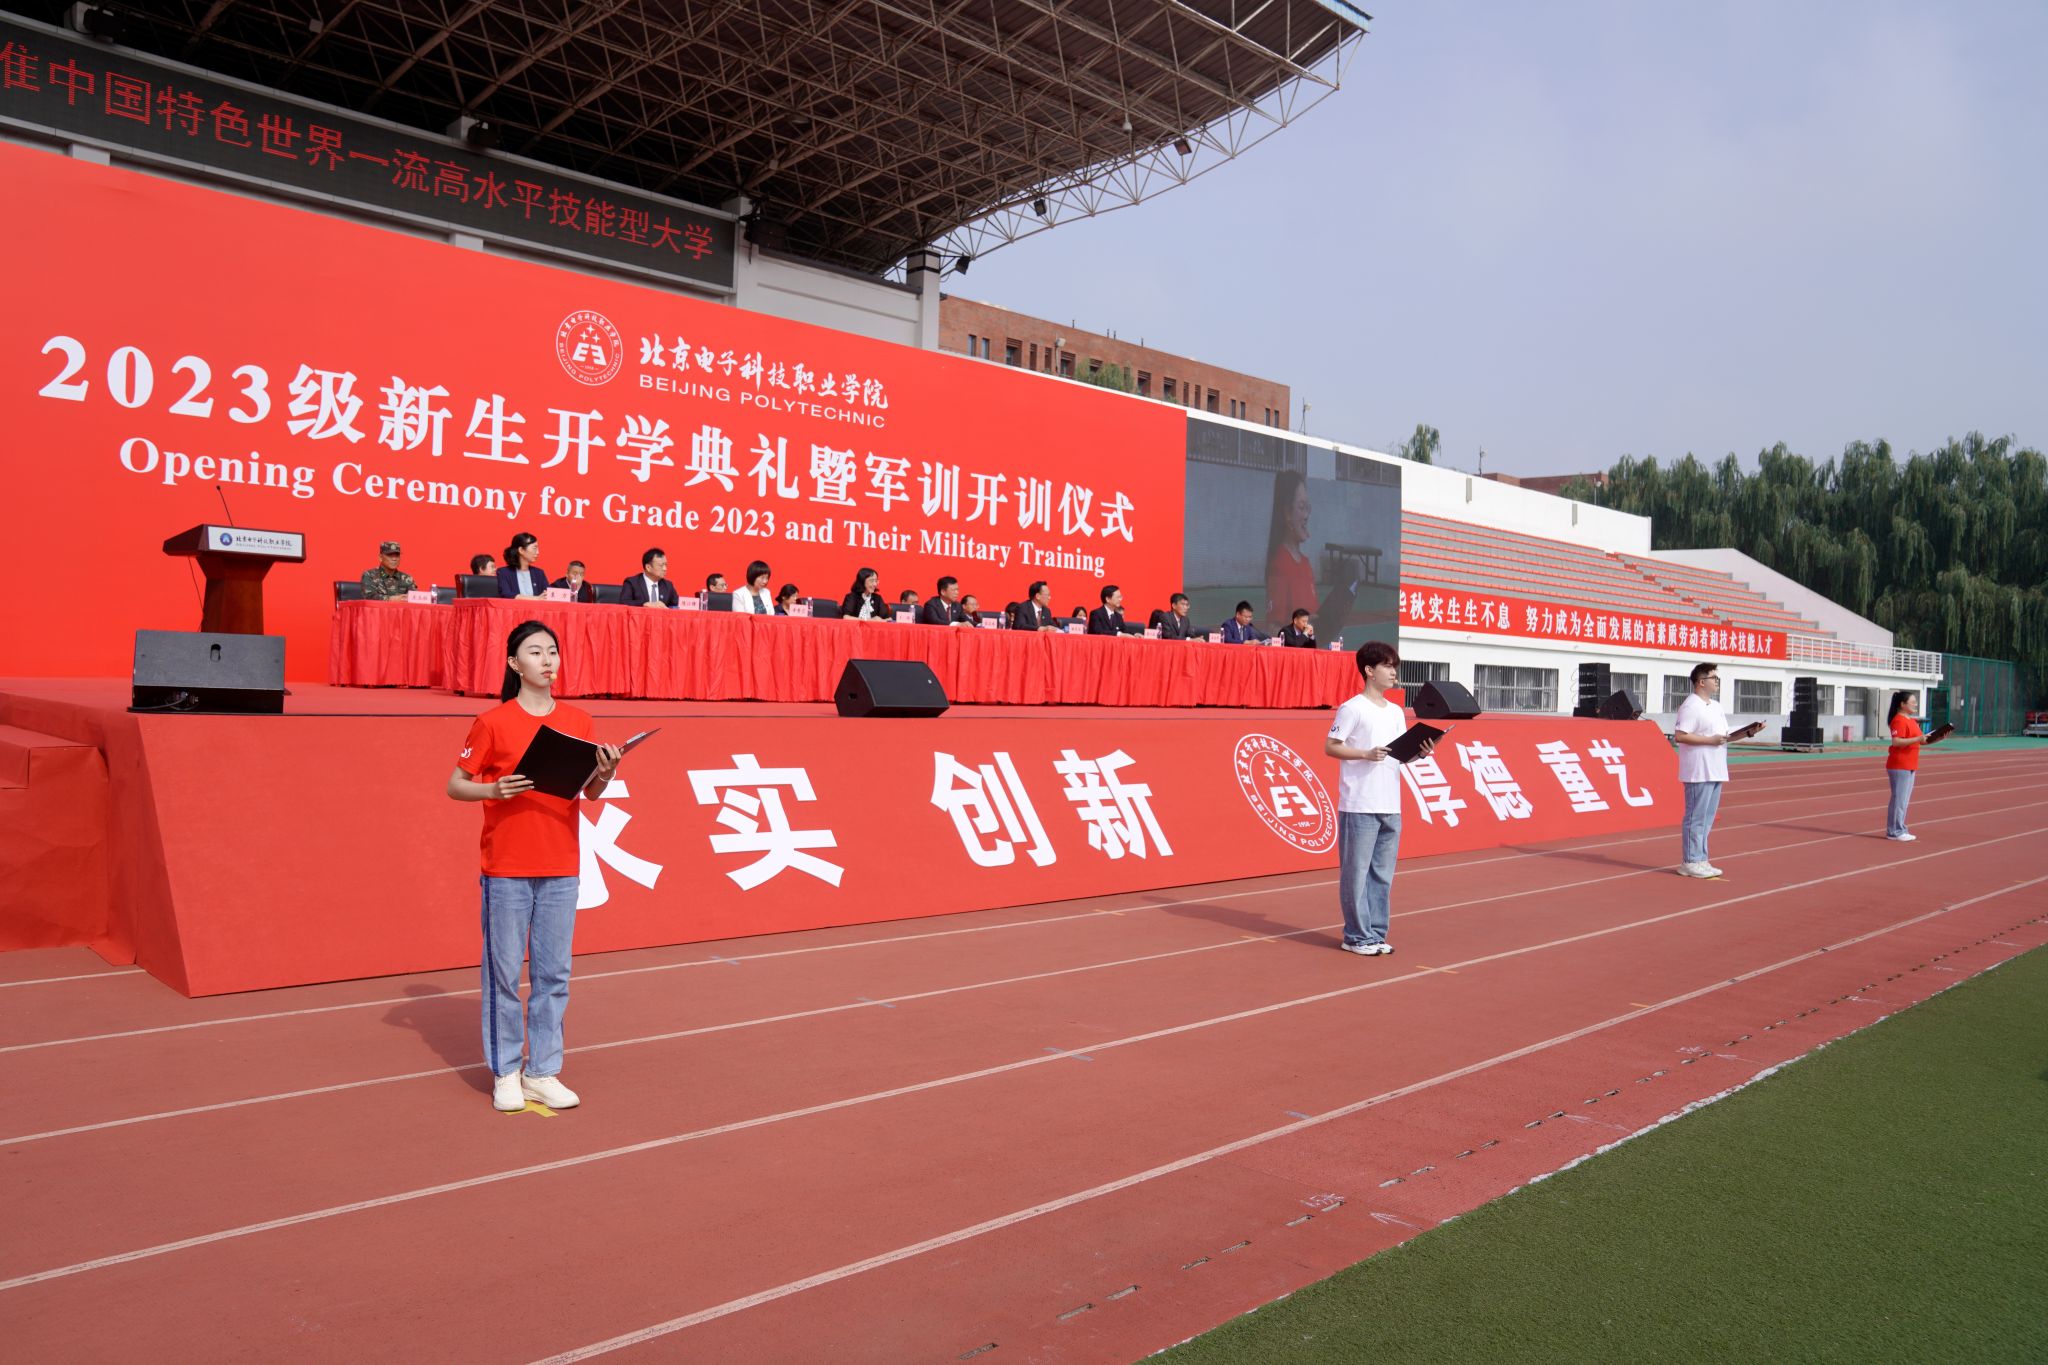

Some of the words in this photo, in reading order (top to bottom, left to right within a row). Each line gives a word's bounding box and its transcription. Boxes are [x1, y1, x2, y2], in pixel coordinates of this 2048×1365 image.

[640, 334, 888, 409] 北京电子科技职业学院
[640, 374, 731, 402] BEIJING
[740, 391, 887, 429] POLYTECHNIC
[38, 335, 1134, 543] 2023级新生开学典礼暨军训开训仪式
[119, 437, 316, 499] Opening
[332, 462, 527, 520] Ceremony
[539, 485, 591, 519] for
[602, 493, 700, 531] Grade
[710, 505, 776, 538] 2023
[785, 518, 834, 544] and
[843, 520, 912, 552] Their
[919, 529, 1012, 568] Military
[1018, 540, 1105, 578] Training
[1526, 605, 1773, 655] 努力成为全面发展的高素质劳动者和技术技能人才
[929, 748, 1174, 868] 创新
[1535, 738, 1654, 814] 重艺
[1250, 794, 1297, 842] BEIJING
[1300, 791, 1332, 847] POLYTECHNIC
